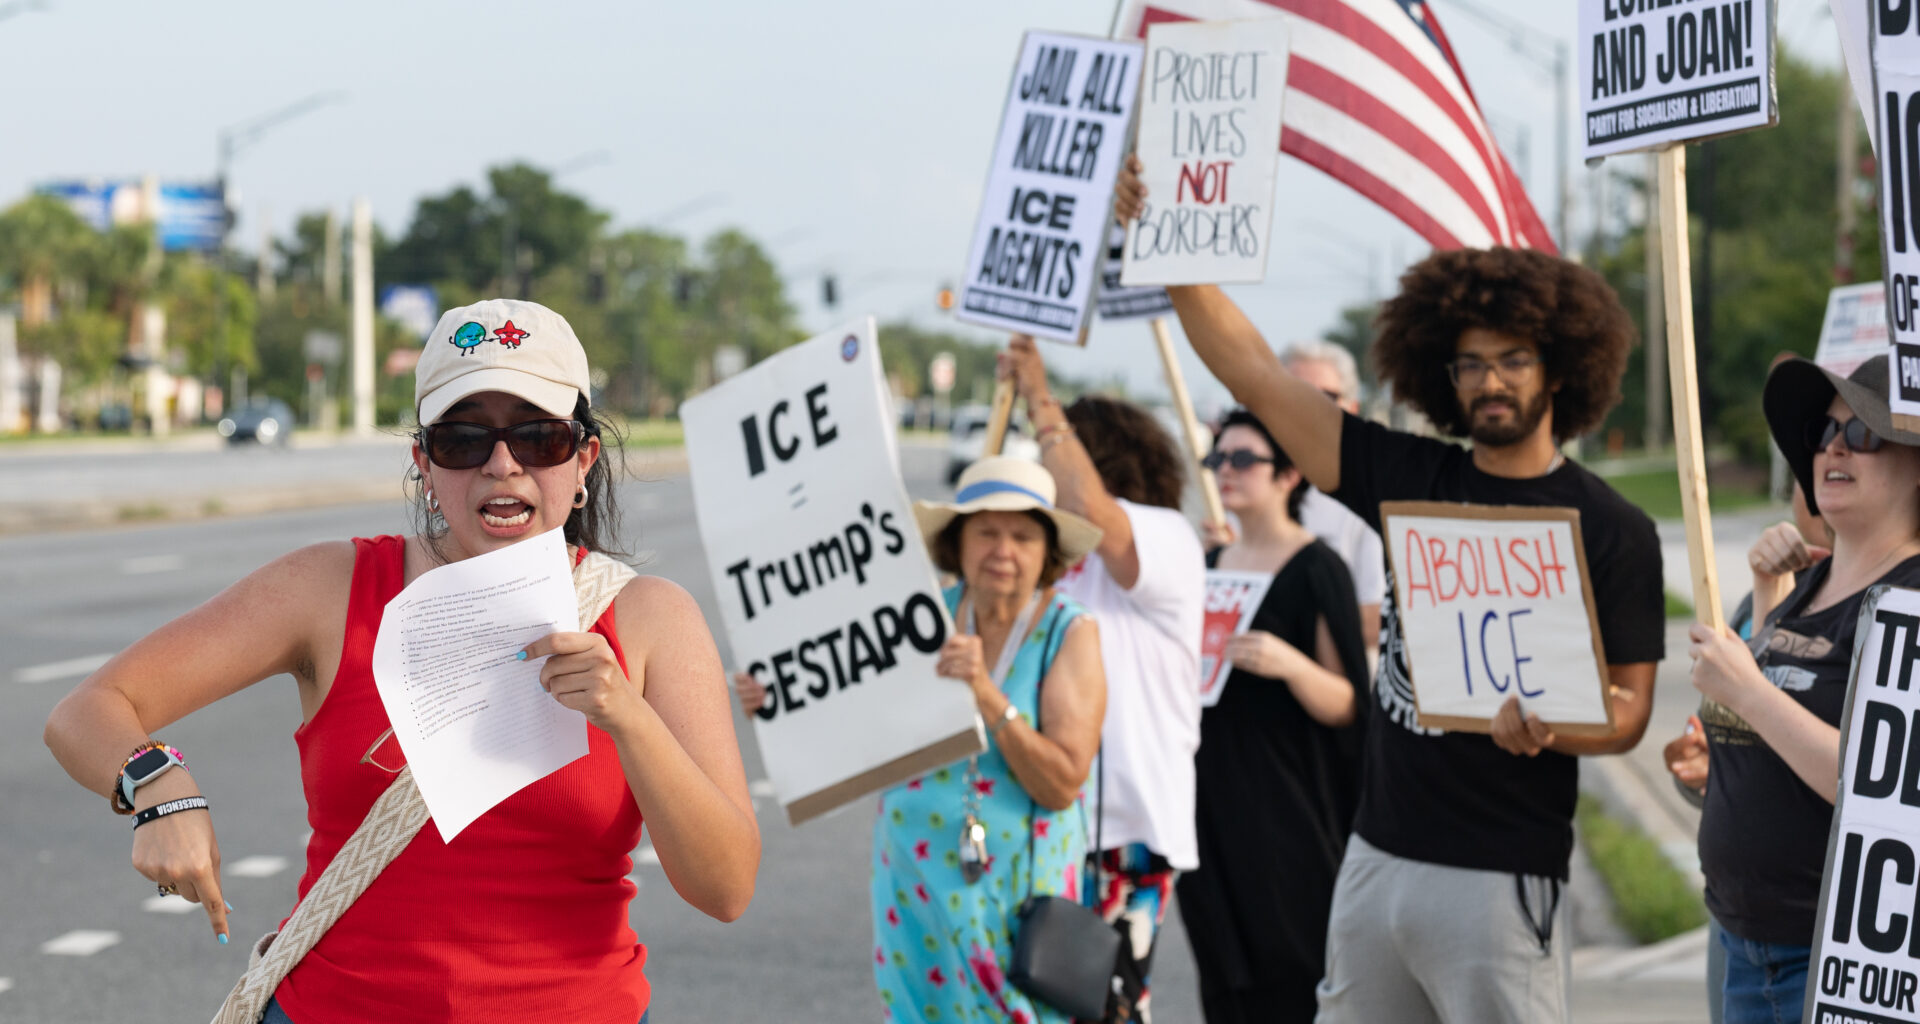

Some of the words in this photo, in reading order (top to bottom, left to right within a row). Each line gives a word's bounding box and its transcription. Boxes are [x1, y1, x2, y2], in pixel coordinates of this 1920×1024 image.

[1020, 45, 1078, 107] JAIL
[1079, 51, 1131, 115] ALL
[1152, 47, 1267, 104] PROTECT
[1592, 24, 1646, 100] AND
[1656, 0, 1754, 84] JOAN!
[1170, 106, 1247, 159] LIVES
[1588, 112, 1617, 138] PARTY
[1618, 109, 1636, 133] FOR
[1636, 96, 1688, 128] SOCIALISM
[1690, 96, 1699, 116] &
[1699, 83, 1758, 115] LIBERATION
[1012, 111, 1105, 181] KILLER
[1008, 186, 1076, 230] ICE
[1176, 160, 1235, 206] NOT
[979, 227, 1082, 300] AGENTS
[1134, 203, 1260, 262] BORDERS
[740, 382, 839, 478] ICE
[726, 502, 906, 620] Trump's
[1405, 527, 1568, 609] ABOLISH
[748, 592, 947, 722] GESTAPO
[1458, 608, 1545, 700] ICE
[1821, 955, 1859, 999] OF
[1859, 963, 1918, 1013] OUR
